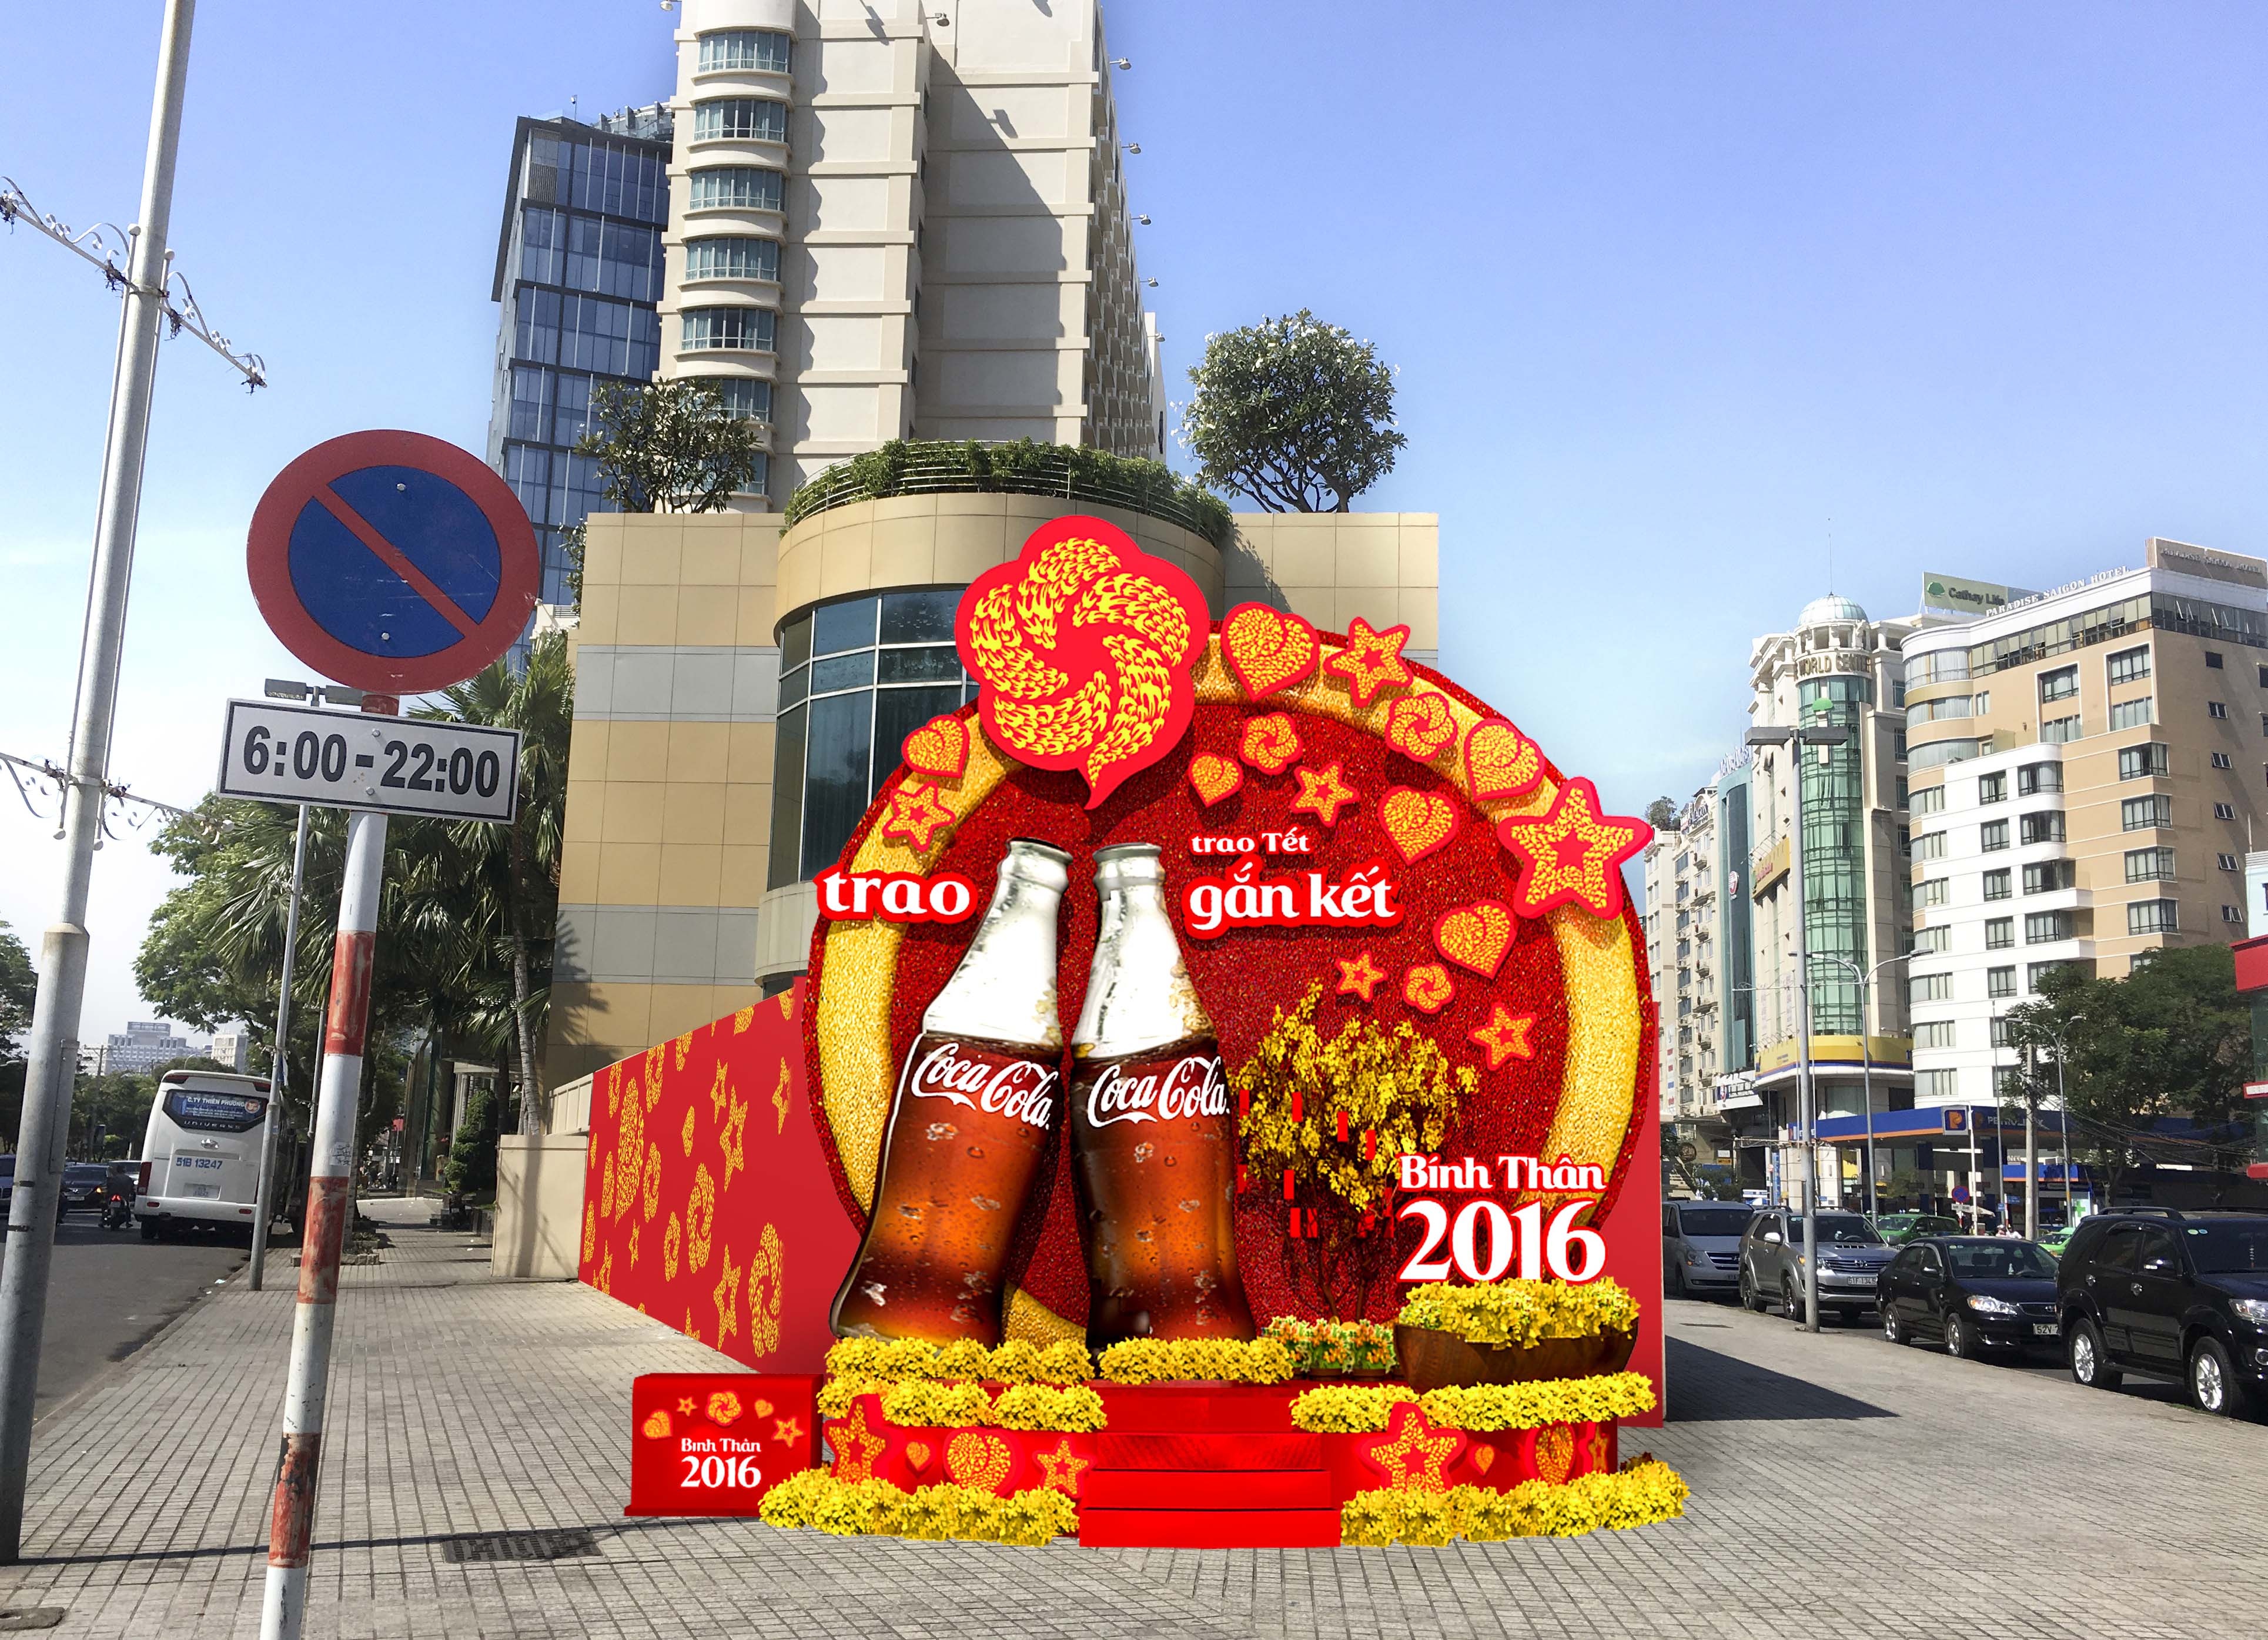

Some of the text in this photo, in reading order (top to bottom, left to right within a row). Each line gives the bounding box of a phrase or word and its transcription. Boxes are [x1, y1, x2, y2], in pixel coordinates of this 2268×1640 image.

[1949, 588, 1983, 605] Cathay
[1986, 565, 2129, 617] PARADISE SAIGON HOTEL
[1799, 655, 1832, 677] WORLD
[1192, 827, 1310, 852] trao Tết
[823, 872, 969, 915] trao
[1190, 862, 1396, 930] gắn kết
[176, 1157, 223, 1170] 51B 13247
[1400, 1155, 1608, 1189] Bính Thân
[1399, 1200, 1606, 1281] 2016
[680, 1455, 762, 1488] 2016
